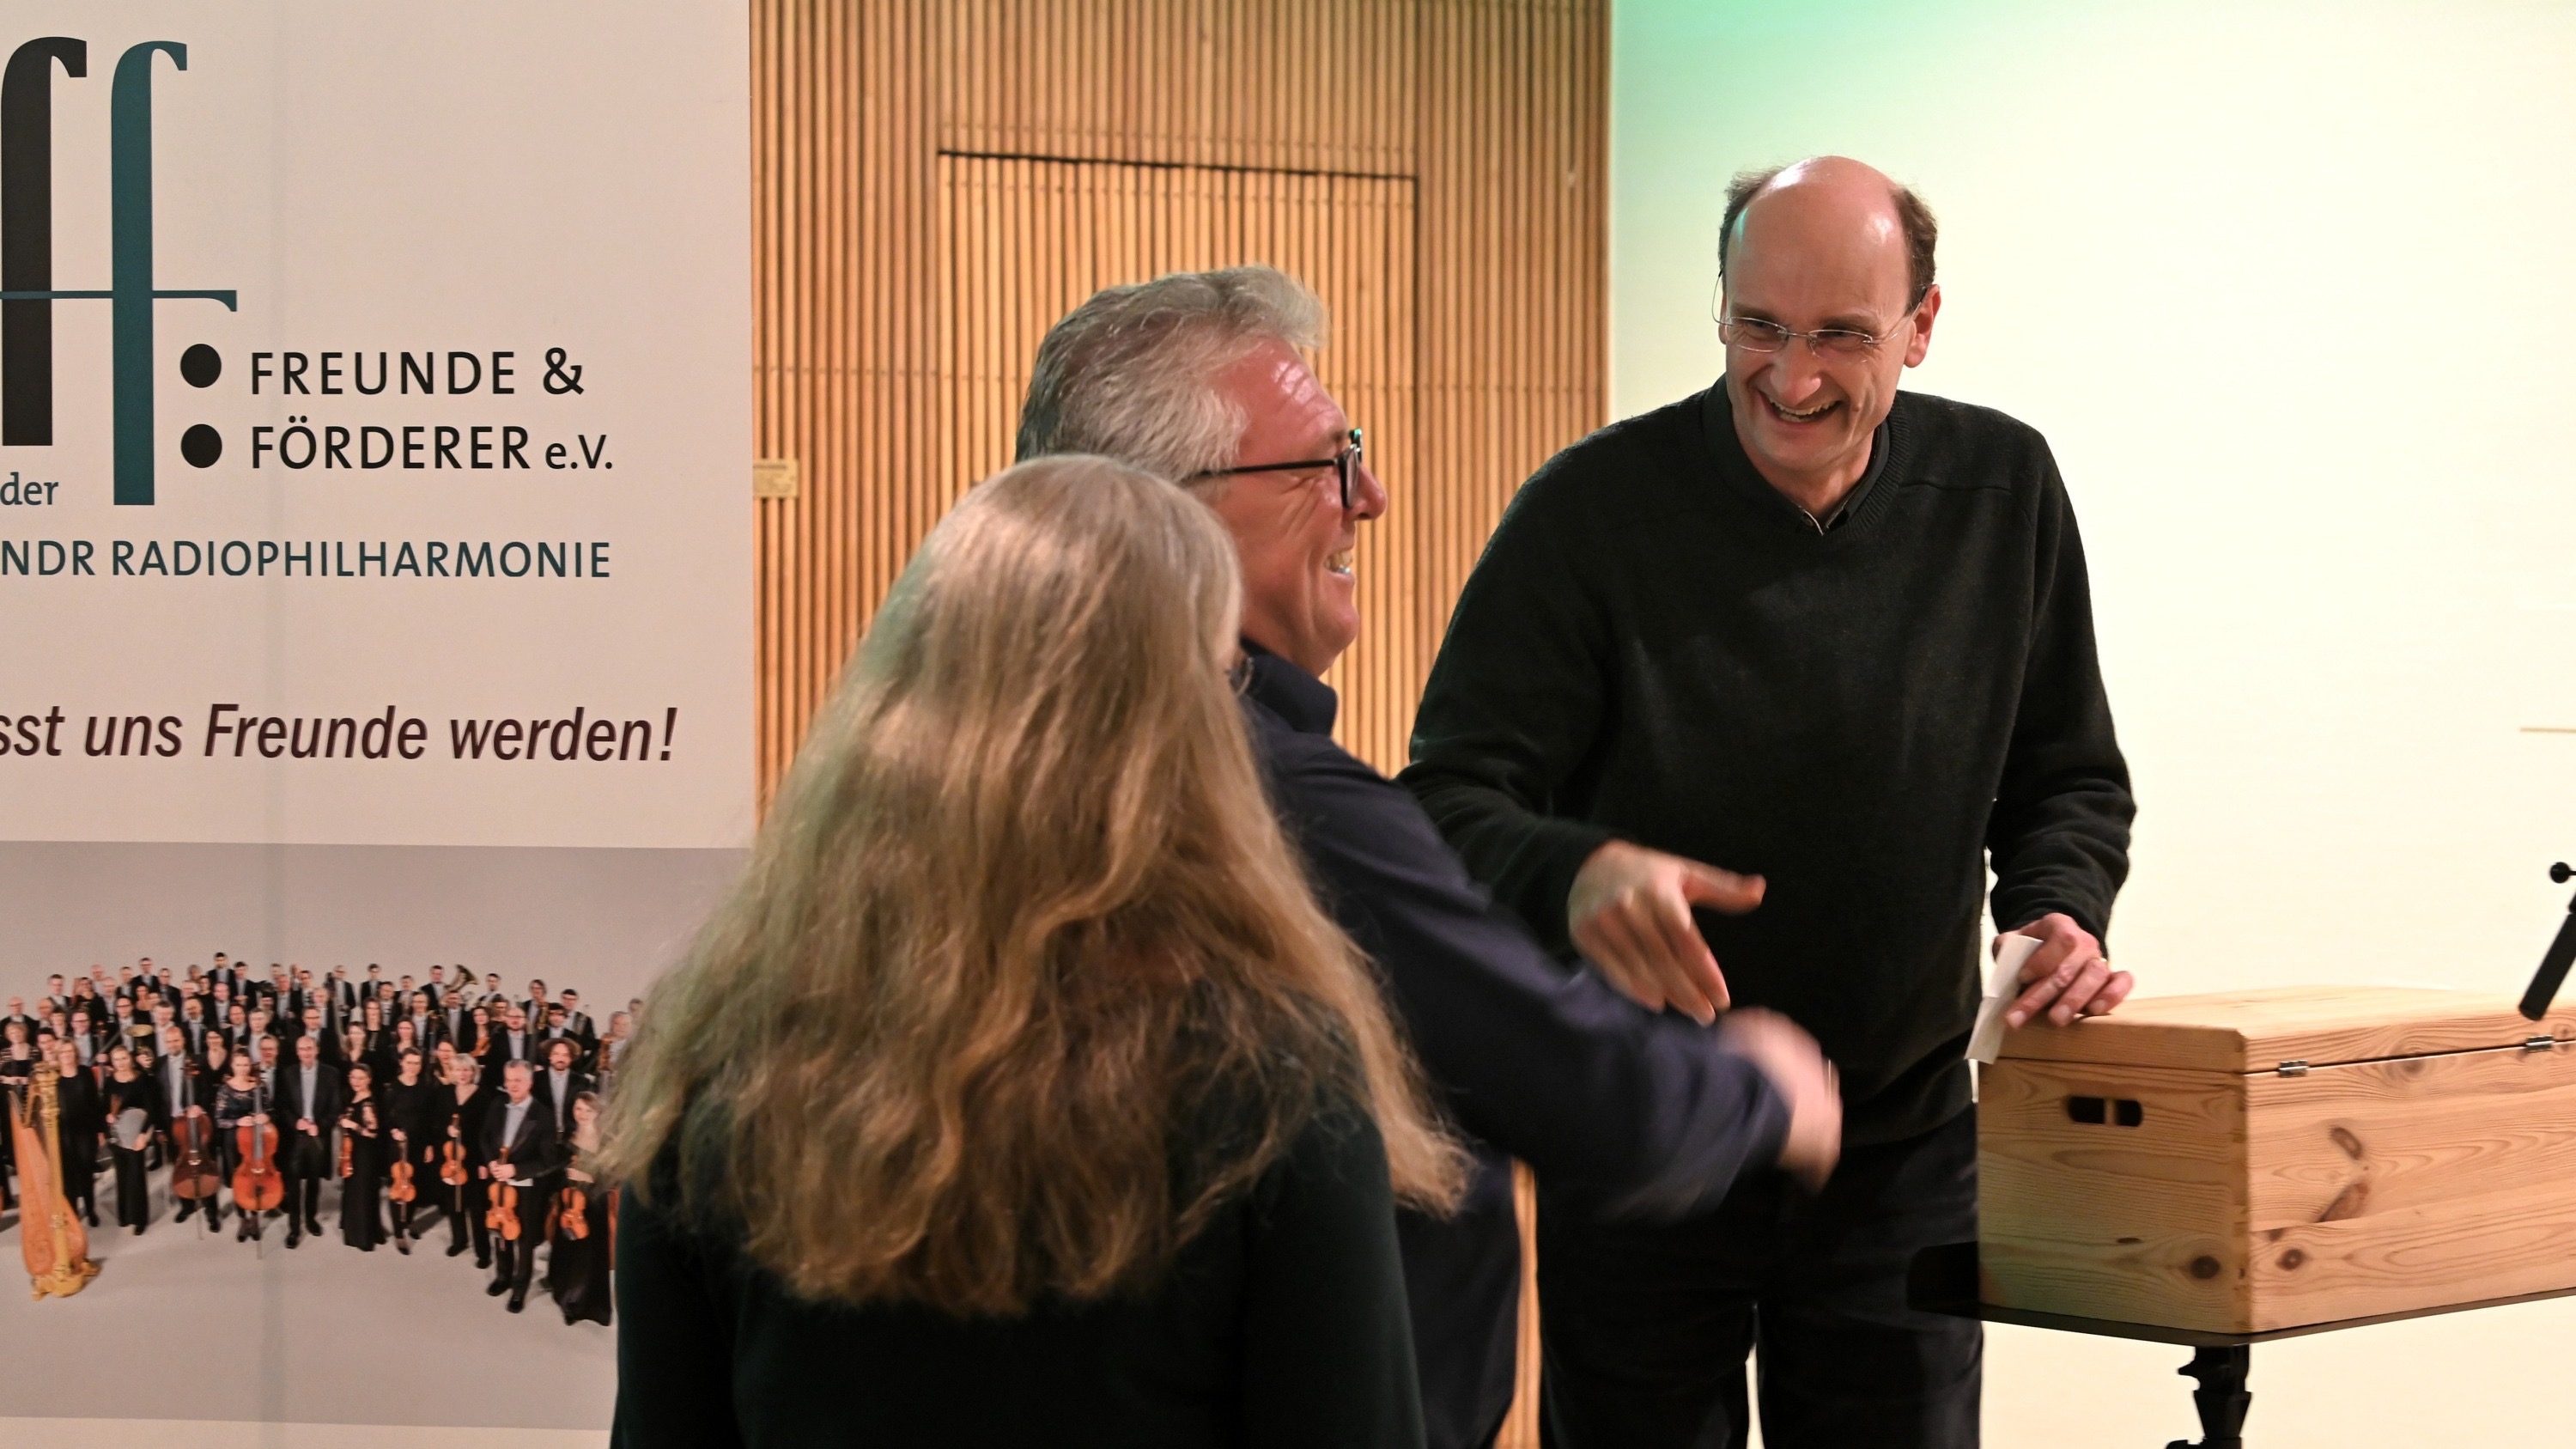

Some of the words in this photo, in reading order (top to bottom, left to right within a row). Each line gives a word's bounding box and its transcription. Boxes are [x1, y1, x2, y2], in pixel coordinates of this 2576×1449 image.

[251, 350, 515, 395] FREUNDE
[543, 347, 585, 395] &
[251, 416, 532, 470] FÖRDERER
[544, 434, 613, 470] e.V.
[0, 471, 59, 506] der
[2, 540, 96, 576] NDR
[112, 540, 611, 578] RADIOPHILHARMONIE
[84, 715, 183, 758] uns
[204, 703, 428, 760] Freunde
[450, 706, 678, 762] werden!
